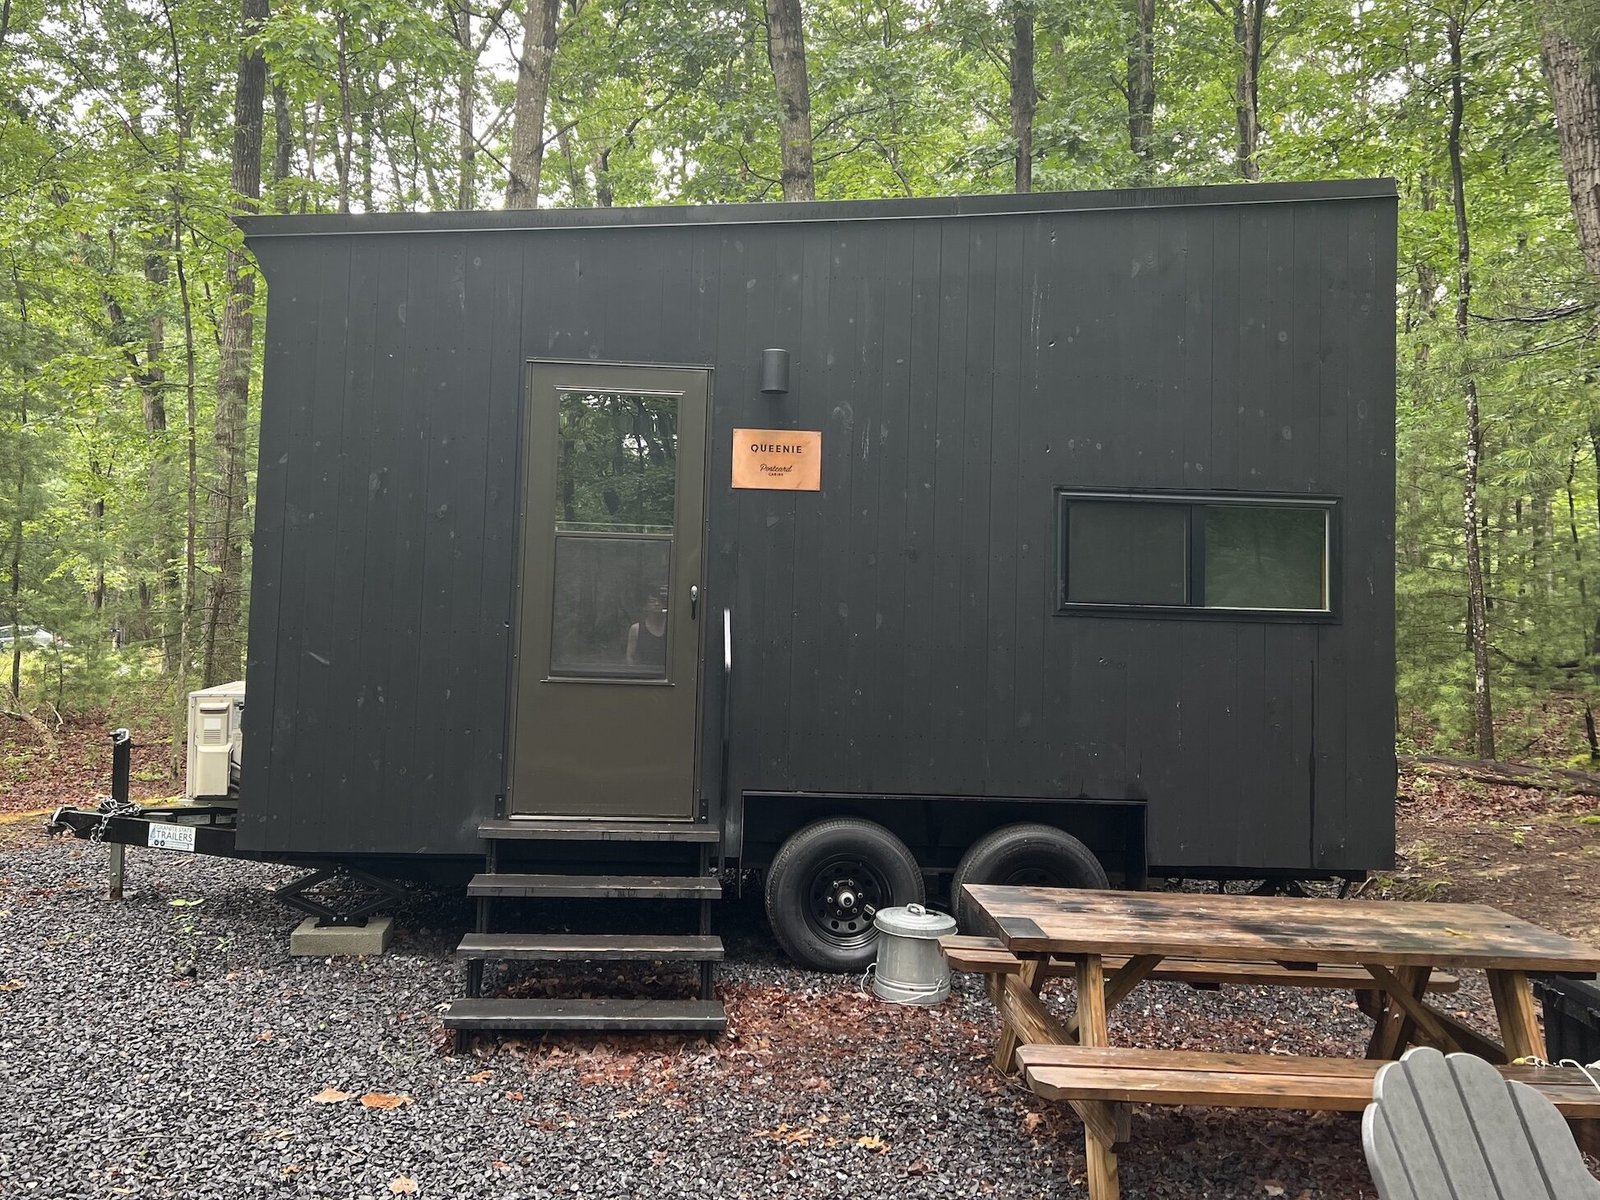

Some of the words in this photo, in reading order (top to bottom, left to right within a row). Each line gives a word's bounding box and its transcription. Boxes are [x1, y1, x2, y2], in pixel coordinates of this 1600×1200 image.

[750, 444, 802, 454] QUEENIE
[759, 463, 793, 473] Postcard
[156, 830, 193, 842] TRAILERS
